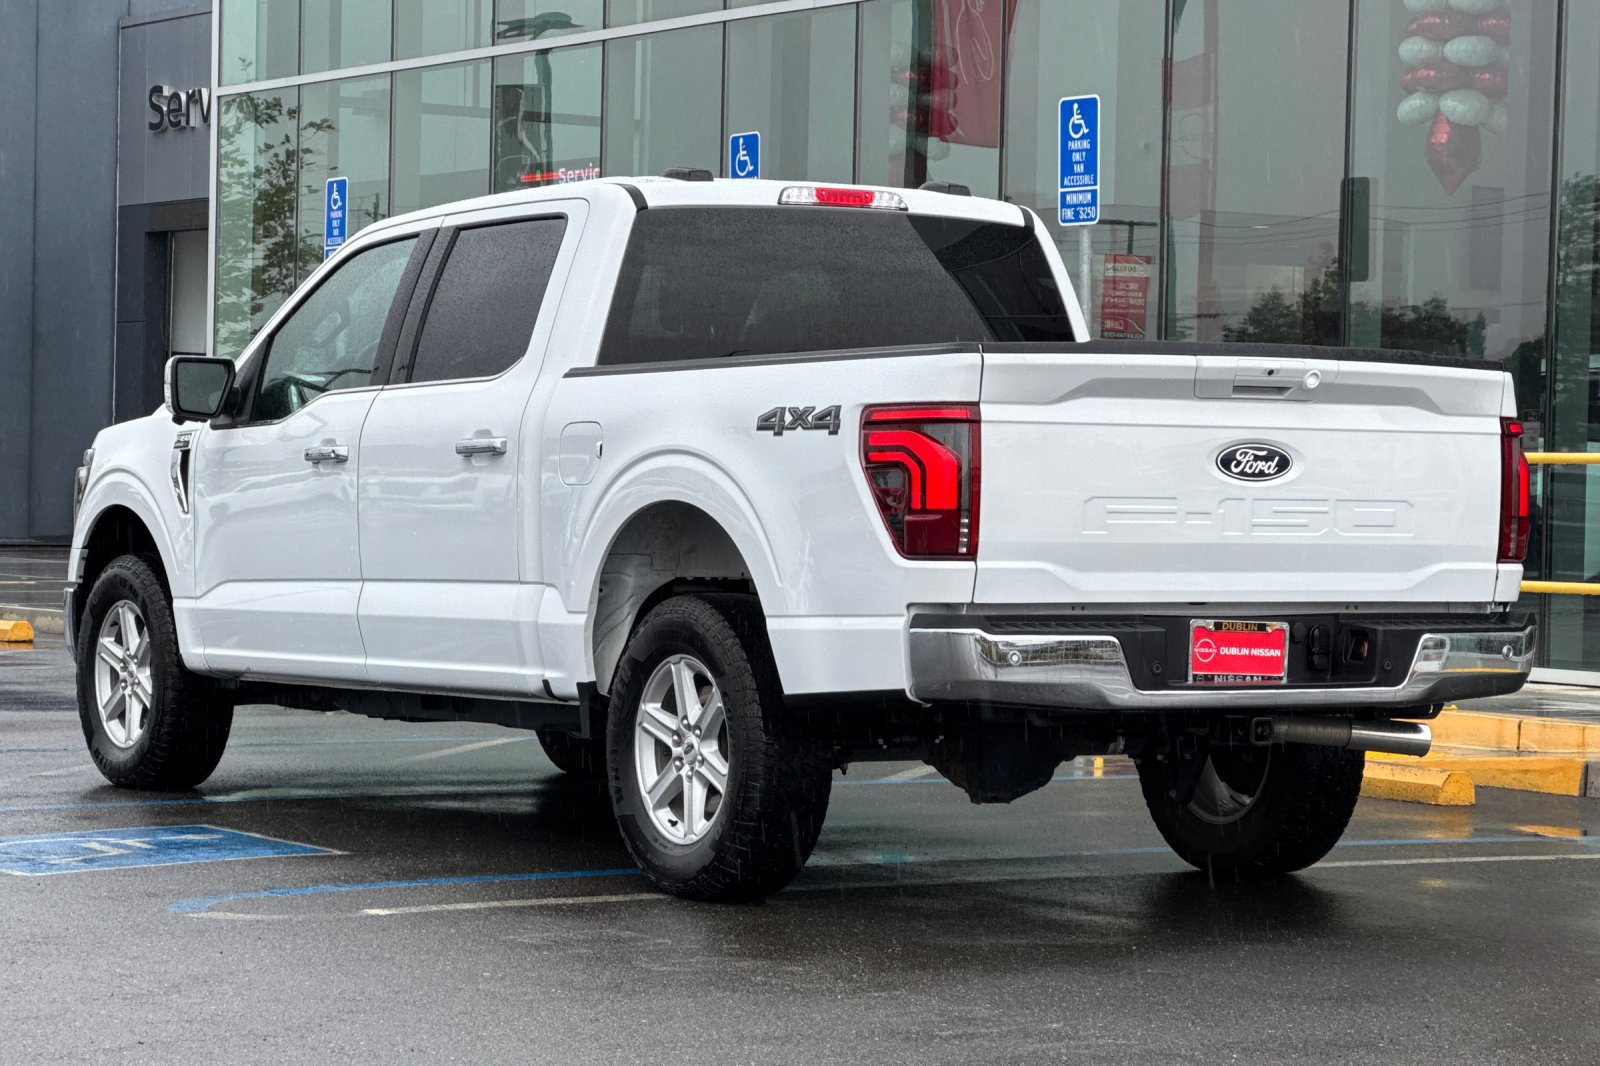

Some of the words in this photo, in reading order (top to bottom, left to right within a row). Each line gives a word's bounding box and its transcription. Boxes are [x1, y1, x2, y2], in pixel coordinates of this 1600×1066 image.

[1068, 139, 1091, 150] PARKING
[1072, 151, 1086, 162] ONLY
[1073, 163, 1084, 173] VAN
[1063, 174, 1094, 186] ACCESSIBLE
[1066, 192, 1092, 205] MINIMUM
[1061, 208, 1075, 220] FINE
[1230, 448, 1279, 475] Ford
[1082, 496, 1415, 537] F-150
[1222, 621, 1258, 631] DUBLIN
[1220, 646, 1249, 656] DUBLIN
[1250, 647, 1281, 657] NISSAN
[1214, 674, 1262, 682] NISSAN
